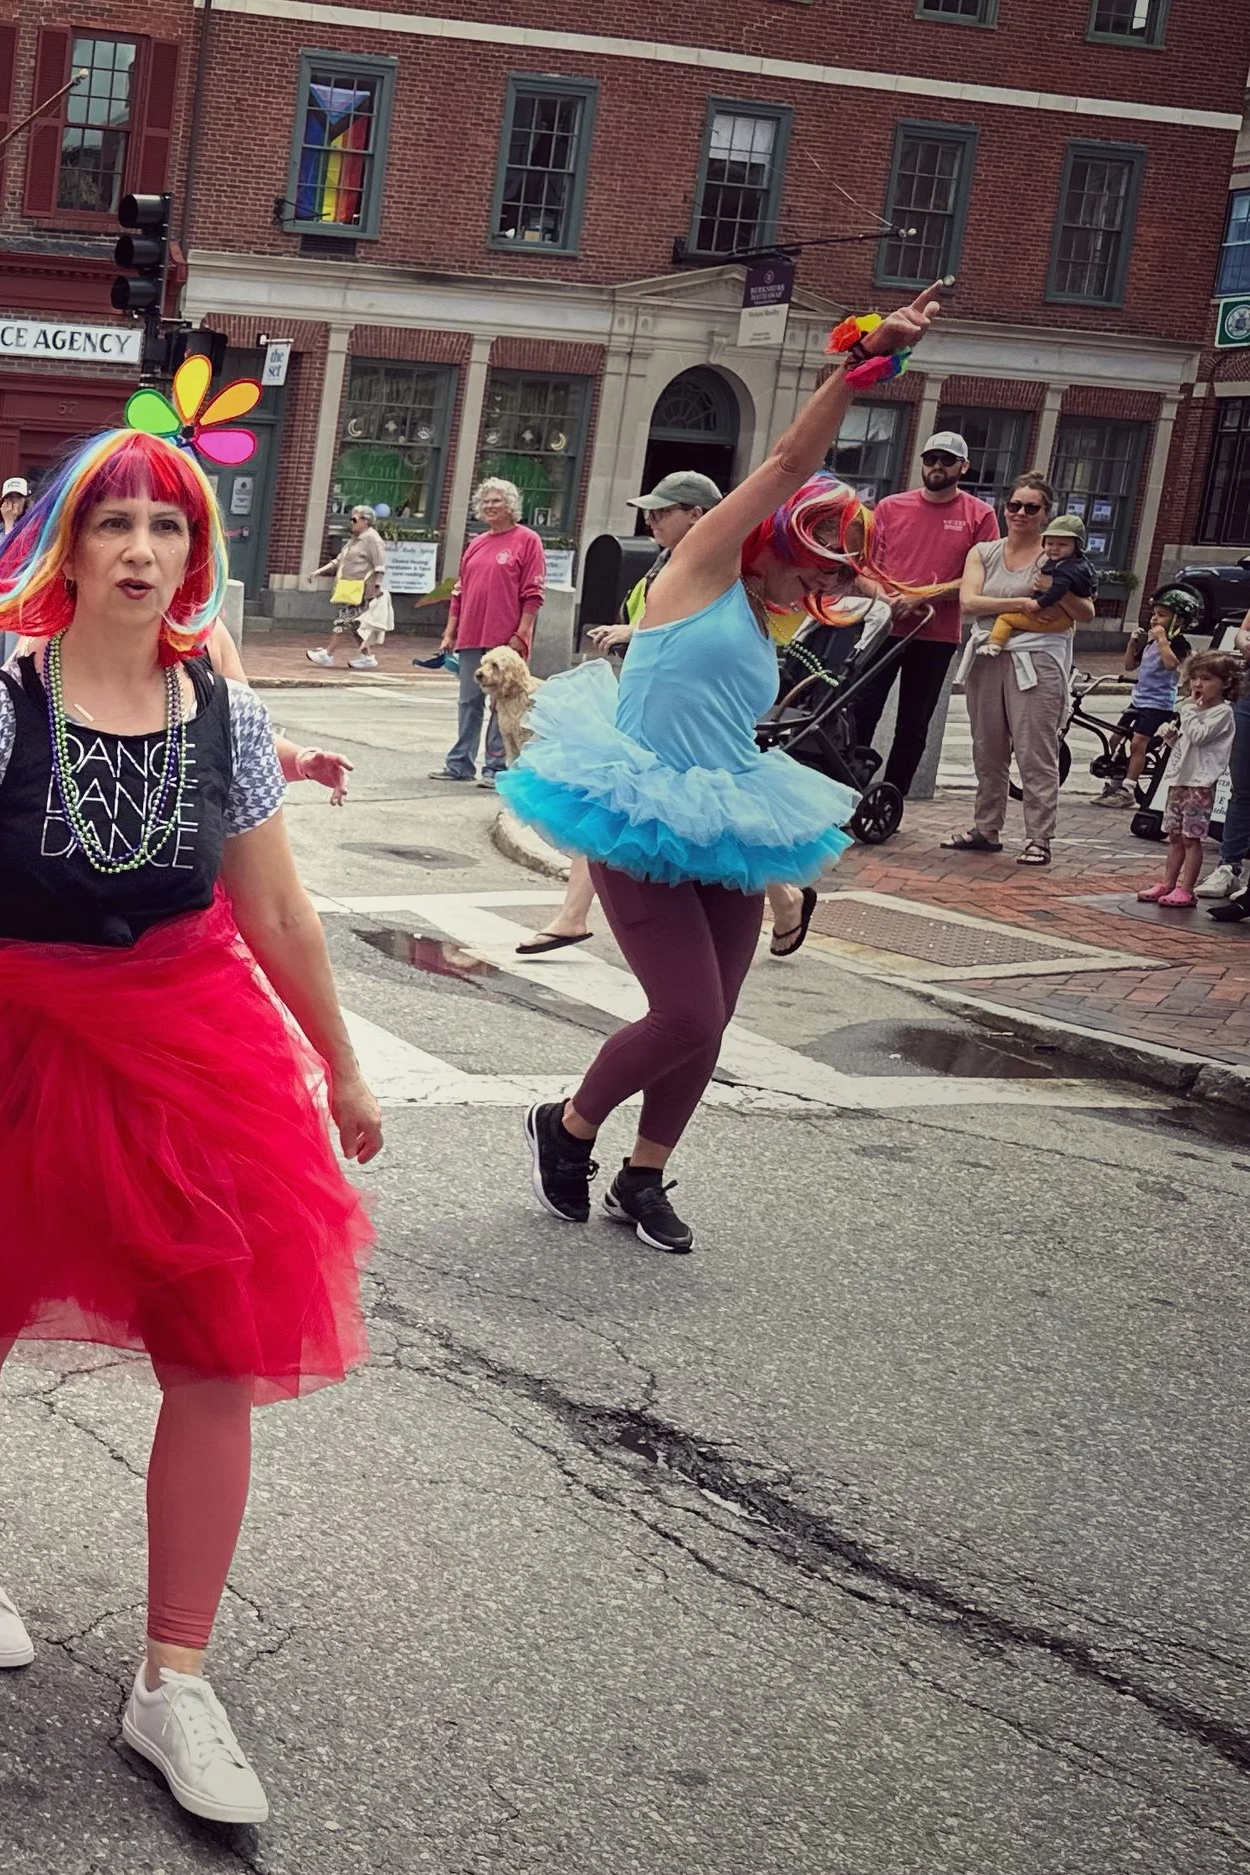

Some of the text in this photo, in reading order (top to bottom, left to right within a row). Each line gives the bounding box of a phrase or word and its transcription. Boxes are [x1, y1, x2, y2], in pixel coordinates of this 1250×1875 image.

[33, 329, 133, 354] AGENCY
[57, 400, 79, 416] 57
[62, 733, 198, 782] DANCE
[46, 774, 199, 826] DANCE
[41, 816, 199, 870] DANCE
